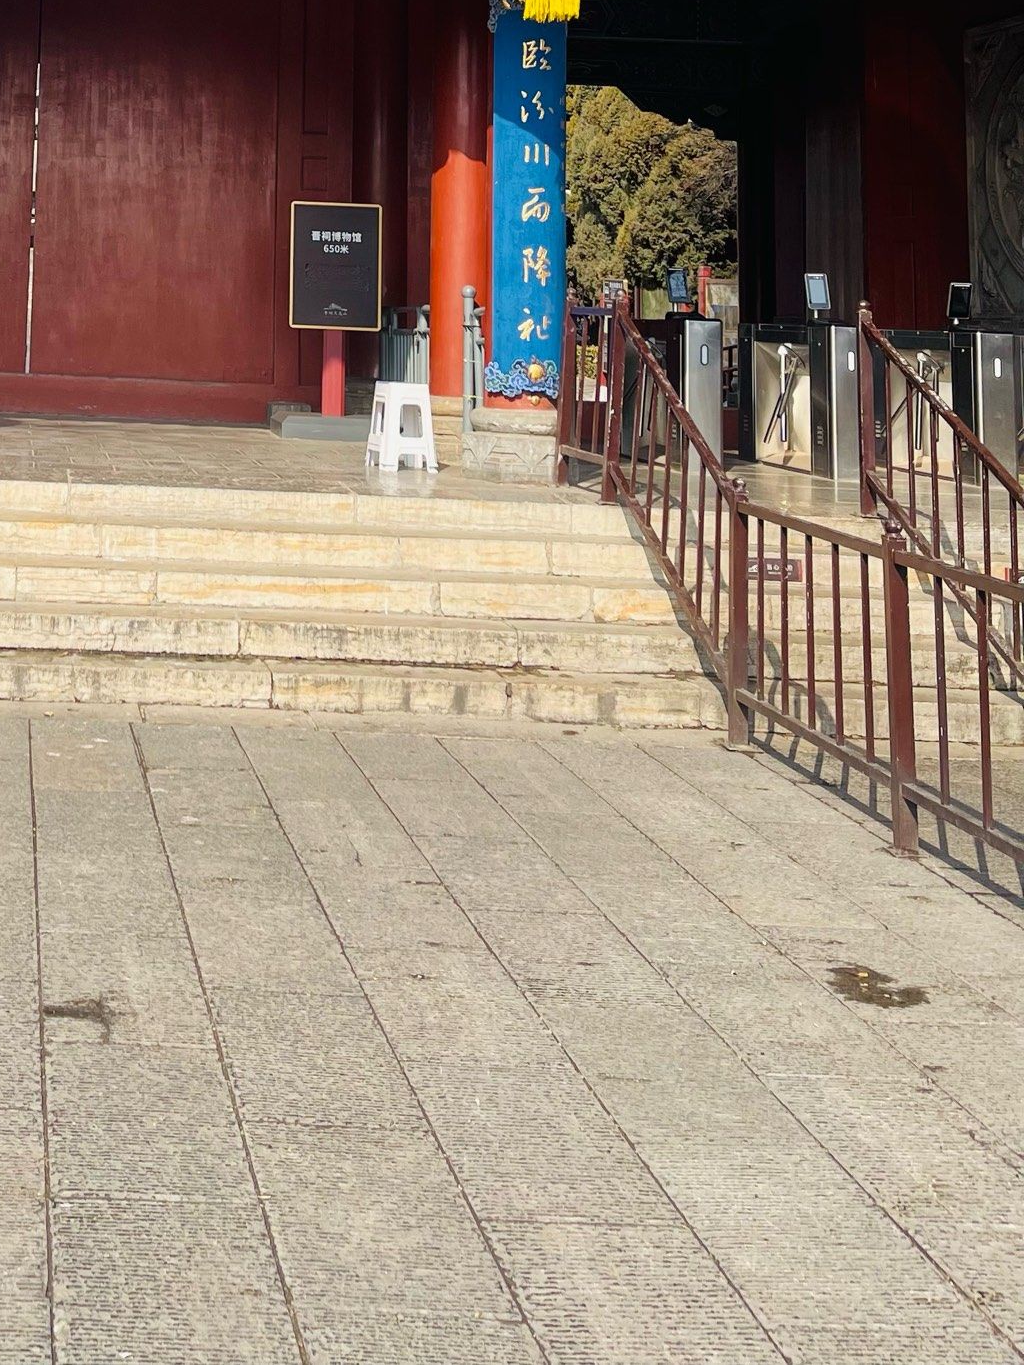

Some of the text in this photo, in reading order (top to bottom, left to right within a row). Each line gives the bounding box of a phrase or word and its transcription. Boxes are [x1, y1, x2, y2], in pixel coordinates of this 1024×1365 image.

[311, 230, 362, 243] 晋祠博物馆
[323, 244, 349, 254] 650米
